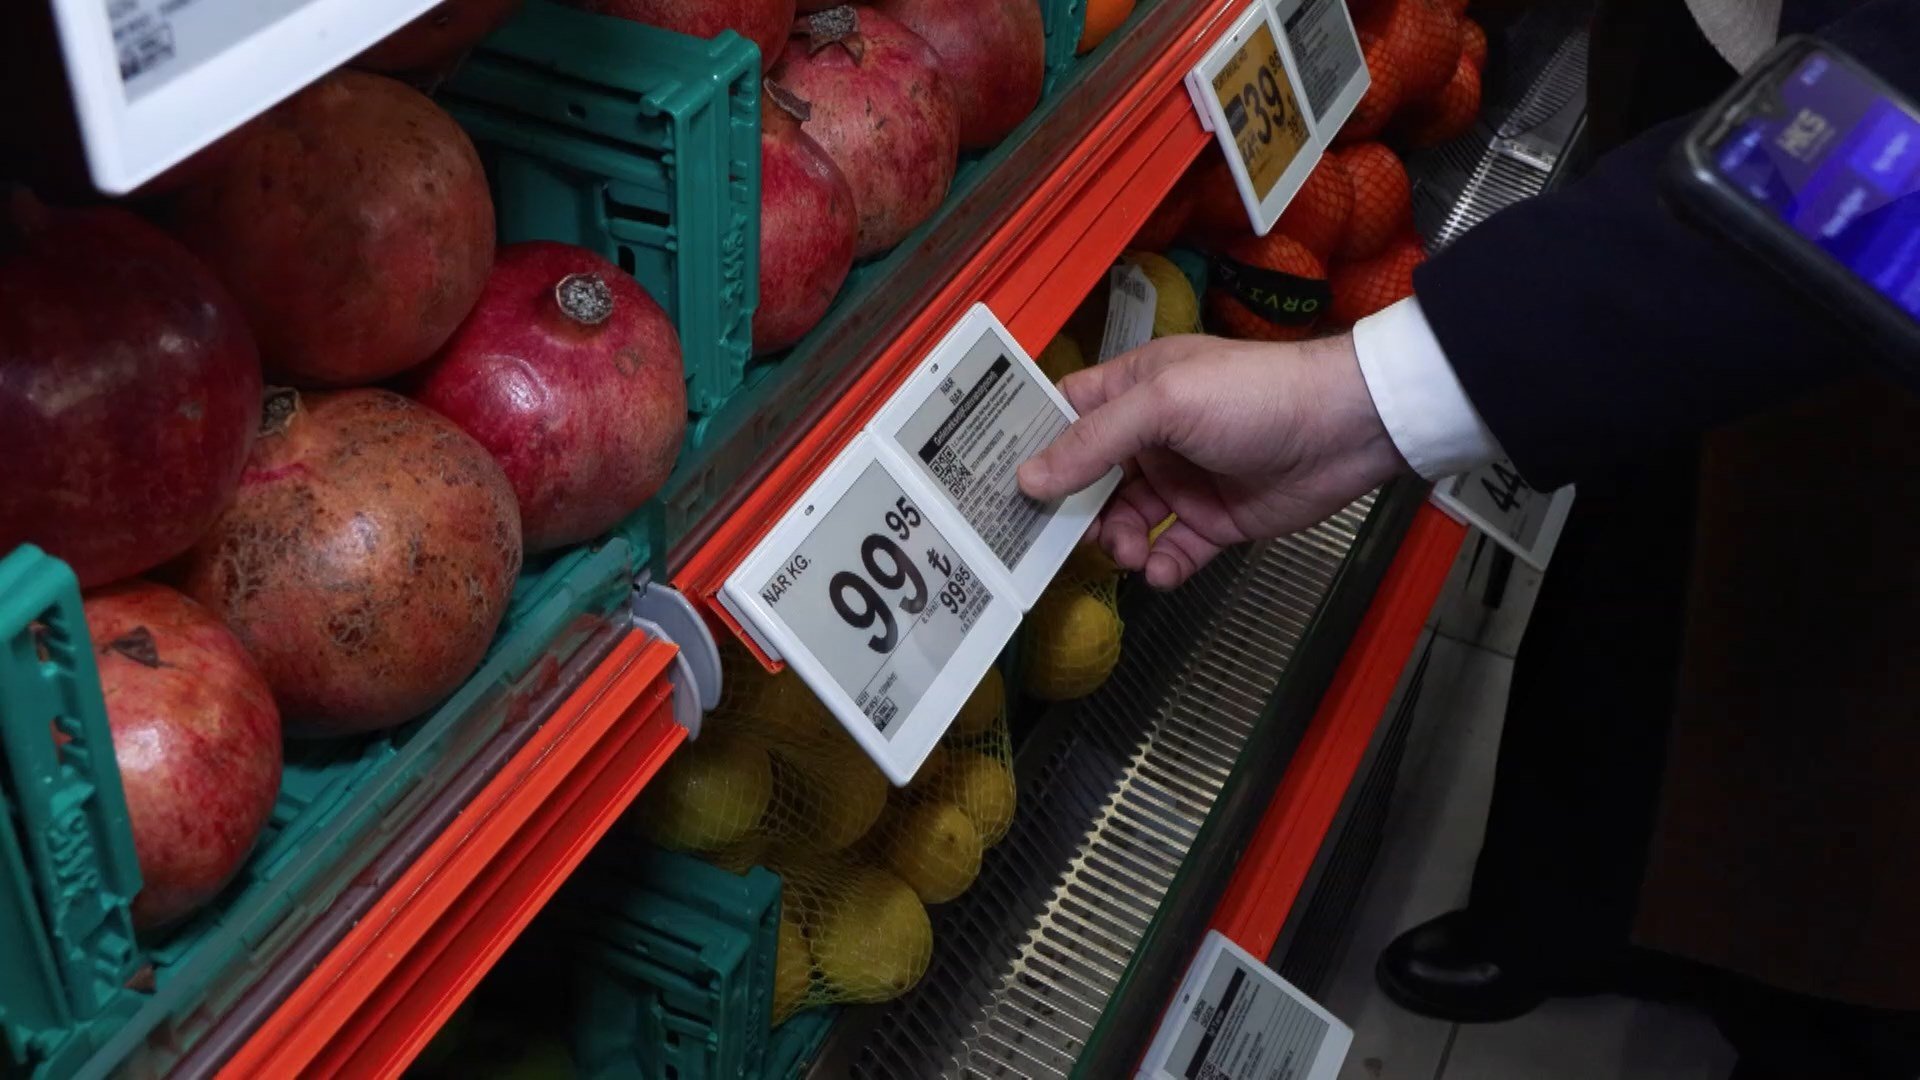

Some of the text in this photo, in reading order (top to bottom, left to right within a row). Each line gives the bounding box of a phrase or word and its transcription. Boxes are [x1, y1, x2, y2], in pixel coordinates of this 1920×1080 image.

[1244, 64, 1285, 144] 39
[1480, 462, 1528, 513] 44
[762, 555, 811, 607] NAR KG.
[829, 533, 929, 654] 99
[885, 497, 922, 541] 95
[940, 566, 971, 614] 99 95
